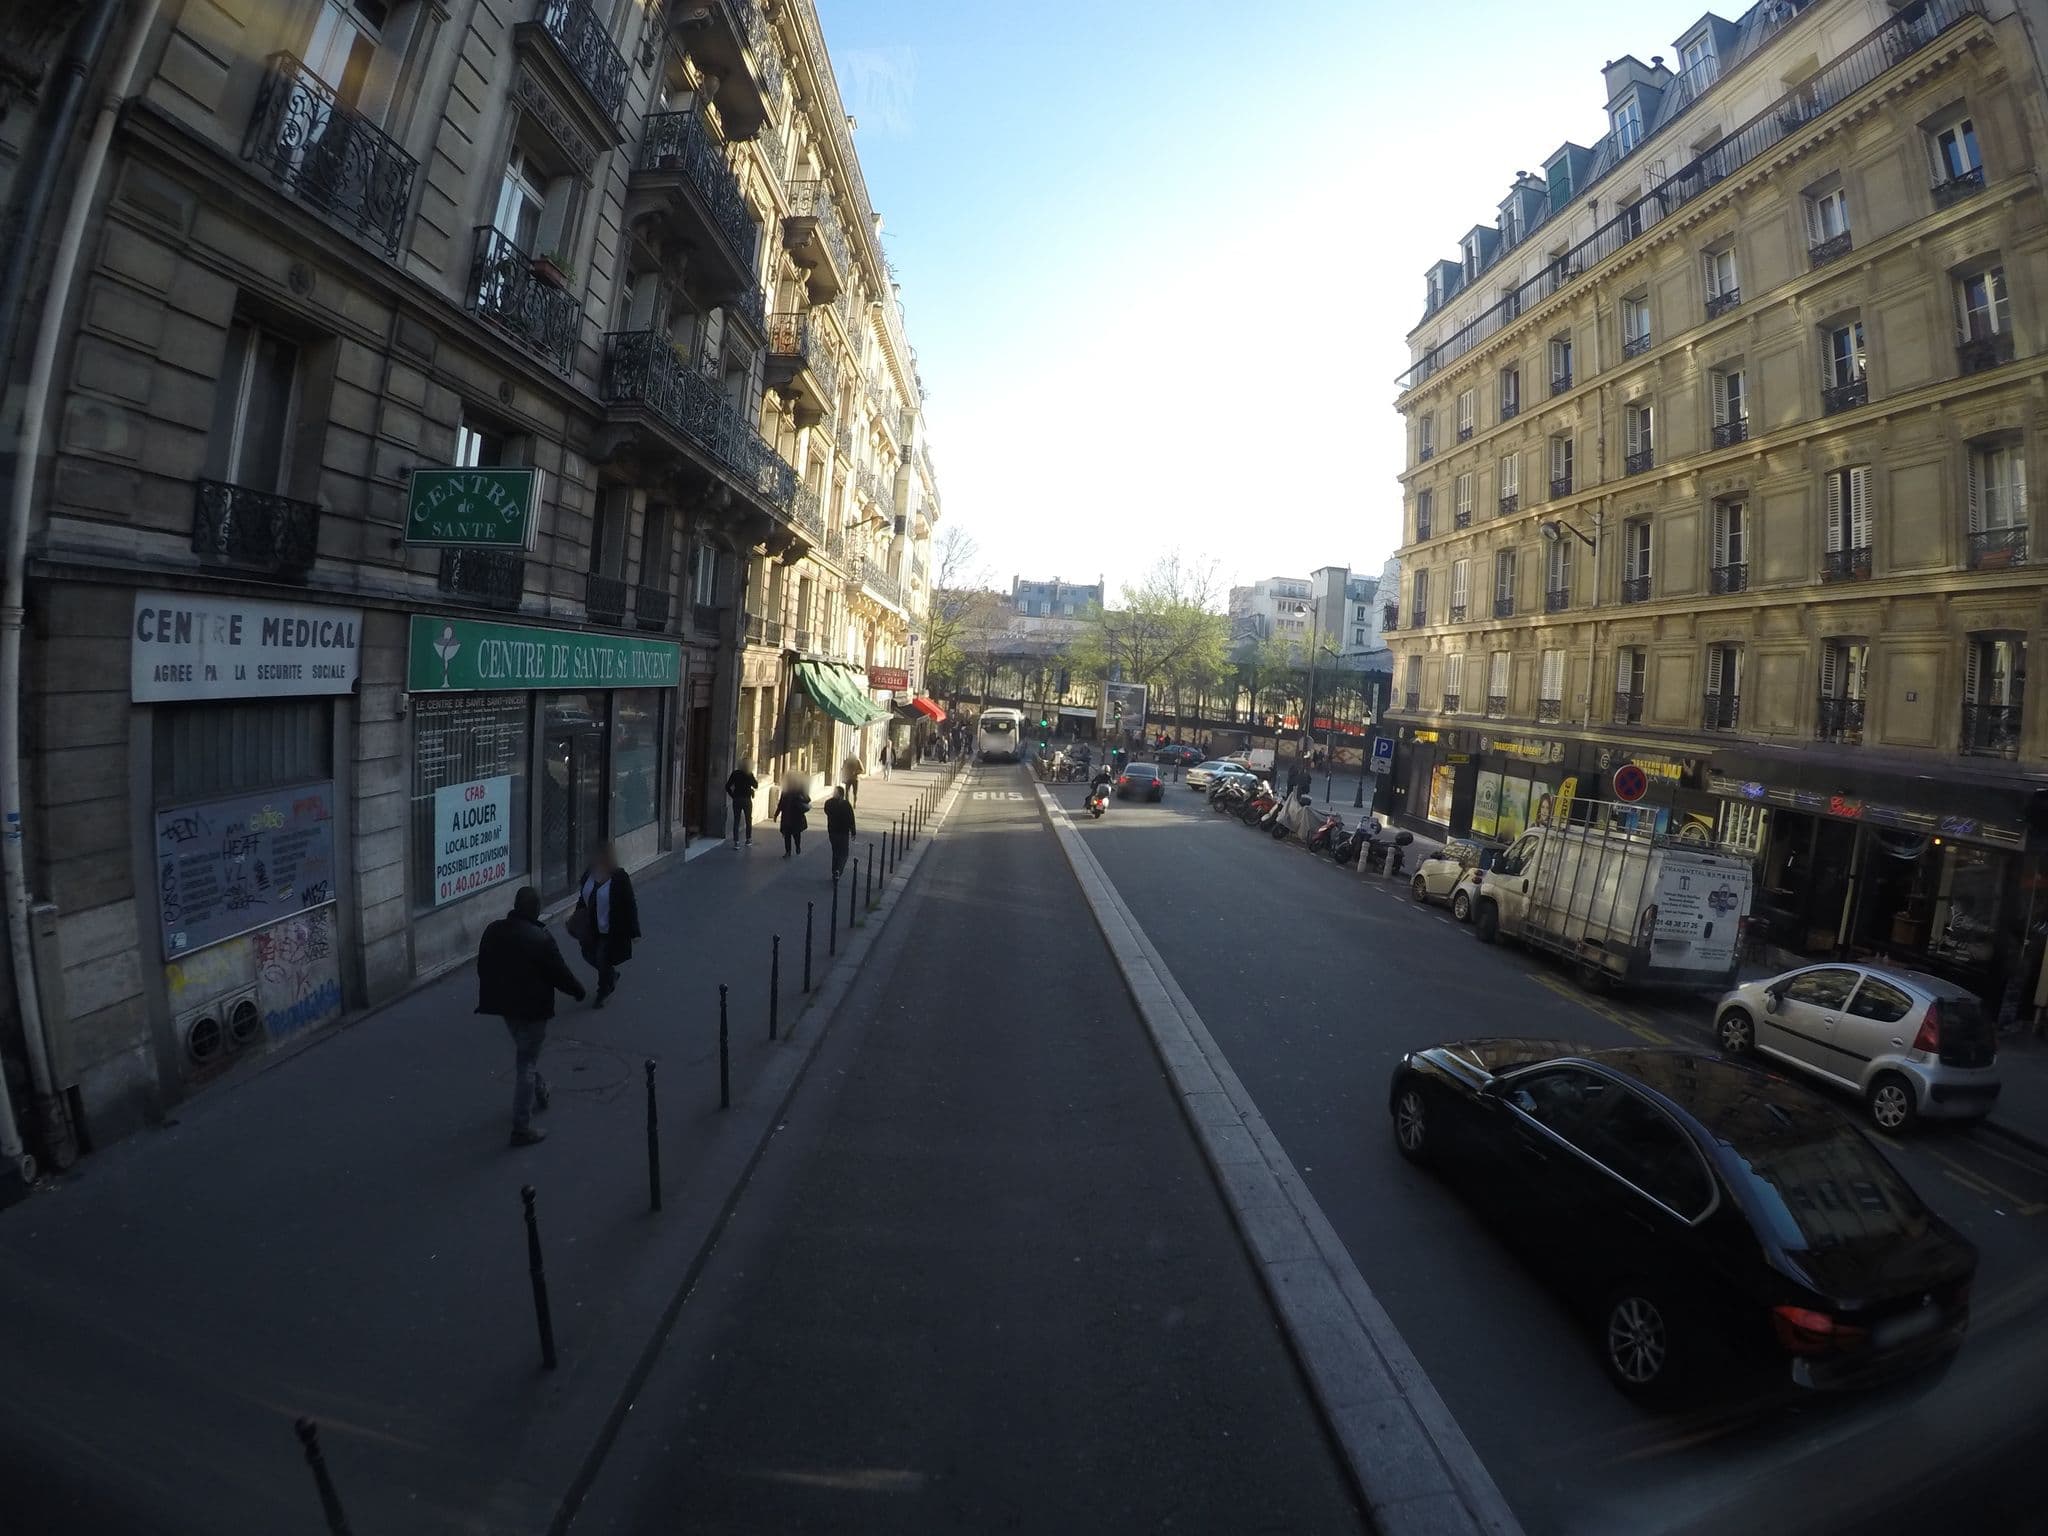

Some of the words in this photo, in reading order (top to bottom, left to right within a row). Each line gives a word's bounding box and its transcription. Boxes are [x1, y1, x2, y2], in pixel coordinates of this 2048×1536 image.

[414, 475, 521, 524] CENTRE
[457, 498, 475, 513] de
[432, 521, 497, 539] SANTE
[262, 617, 355, 649] MEDICAL
[477, 638, 546, 680] CENTRE
[551, 643, 570, 680] DE
[573, 645, 614, 680] SANTE
[632, 651, 672, 680] VINCENT
[153, 664, 193, 682] AGREE
[235, 664, 246, 680] LA
[257, 664, 303, 681] SECURITE
[312, 664, 346, 680] SOCIALE
[874, 675, 903, 685] RADIO
[1380, 741, 1389, 755] P
[465, 785, 485, 801] CFAB
[973, 791, 1024, 801] BUS
[453, 812, 461, 832] A
[463, 804, 497, 829] LOUER
[445, 835, 469, 855] LOCAL
[470, 834, 479, 847] DE
[480, 831, 493, 844] 280
[437, 855, 480, 879] POSSIBILITE
[480, 845, 509, 865] DIVISION
[440, 862, 506, 898] 01.40.02.92.08
